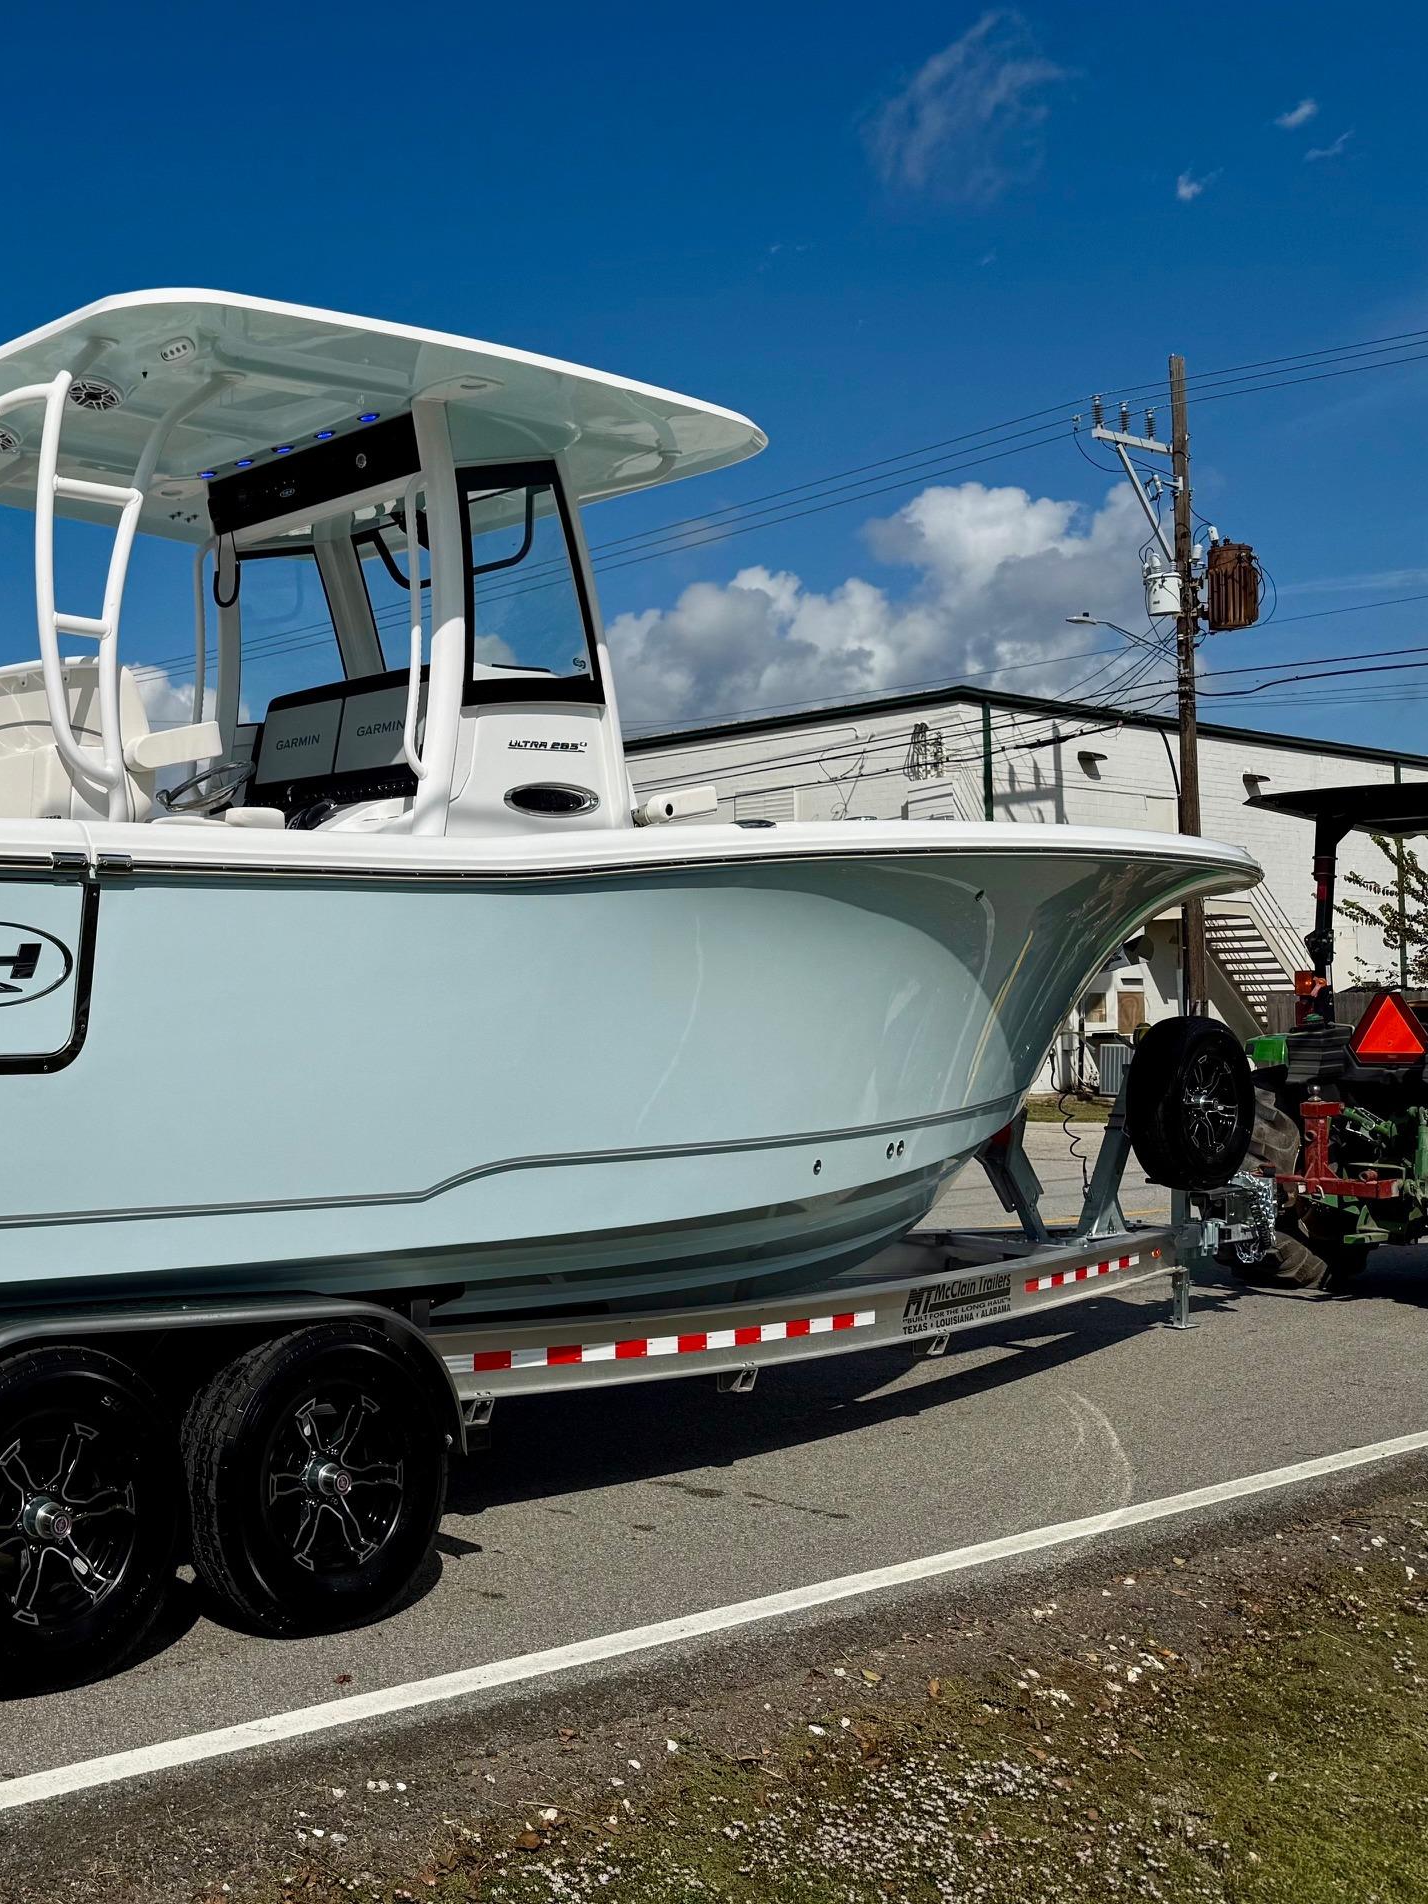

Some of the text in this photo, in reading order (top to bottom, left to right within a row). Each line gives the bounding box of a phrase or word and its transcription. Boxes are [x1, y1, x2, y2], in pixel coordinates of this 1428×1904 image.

[356, 719, 405, 737] GARMIN
[275, 734, 320, 751] GARMIN
[508, 740, 548, 749] ULTRA
[933, 1273, 1011, 1302] McClain Trailers
[902, 1303, 1011, 1336] TEXAS LOUISIANA ALABAMA
[929, 1311, 945, 1320] FOR
[945, 1308, 959, 1316] THE
[961, 1302, 986, 1312] LONG
